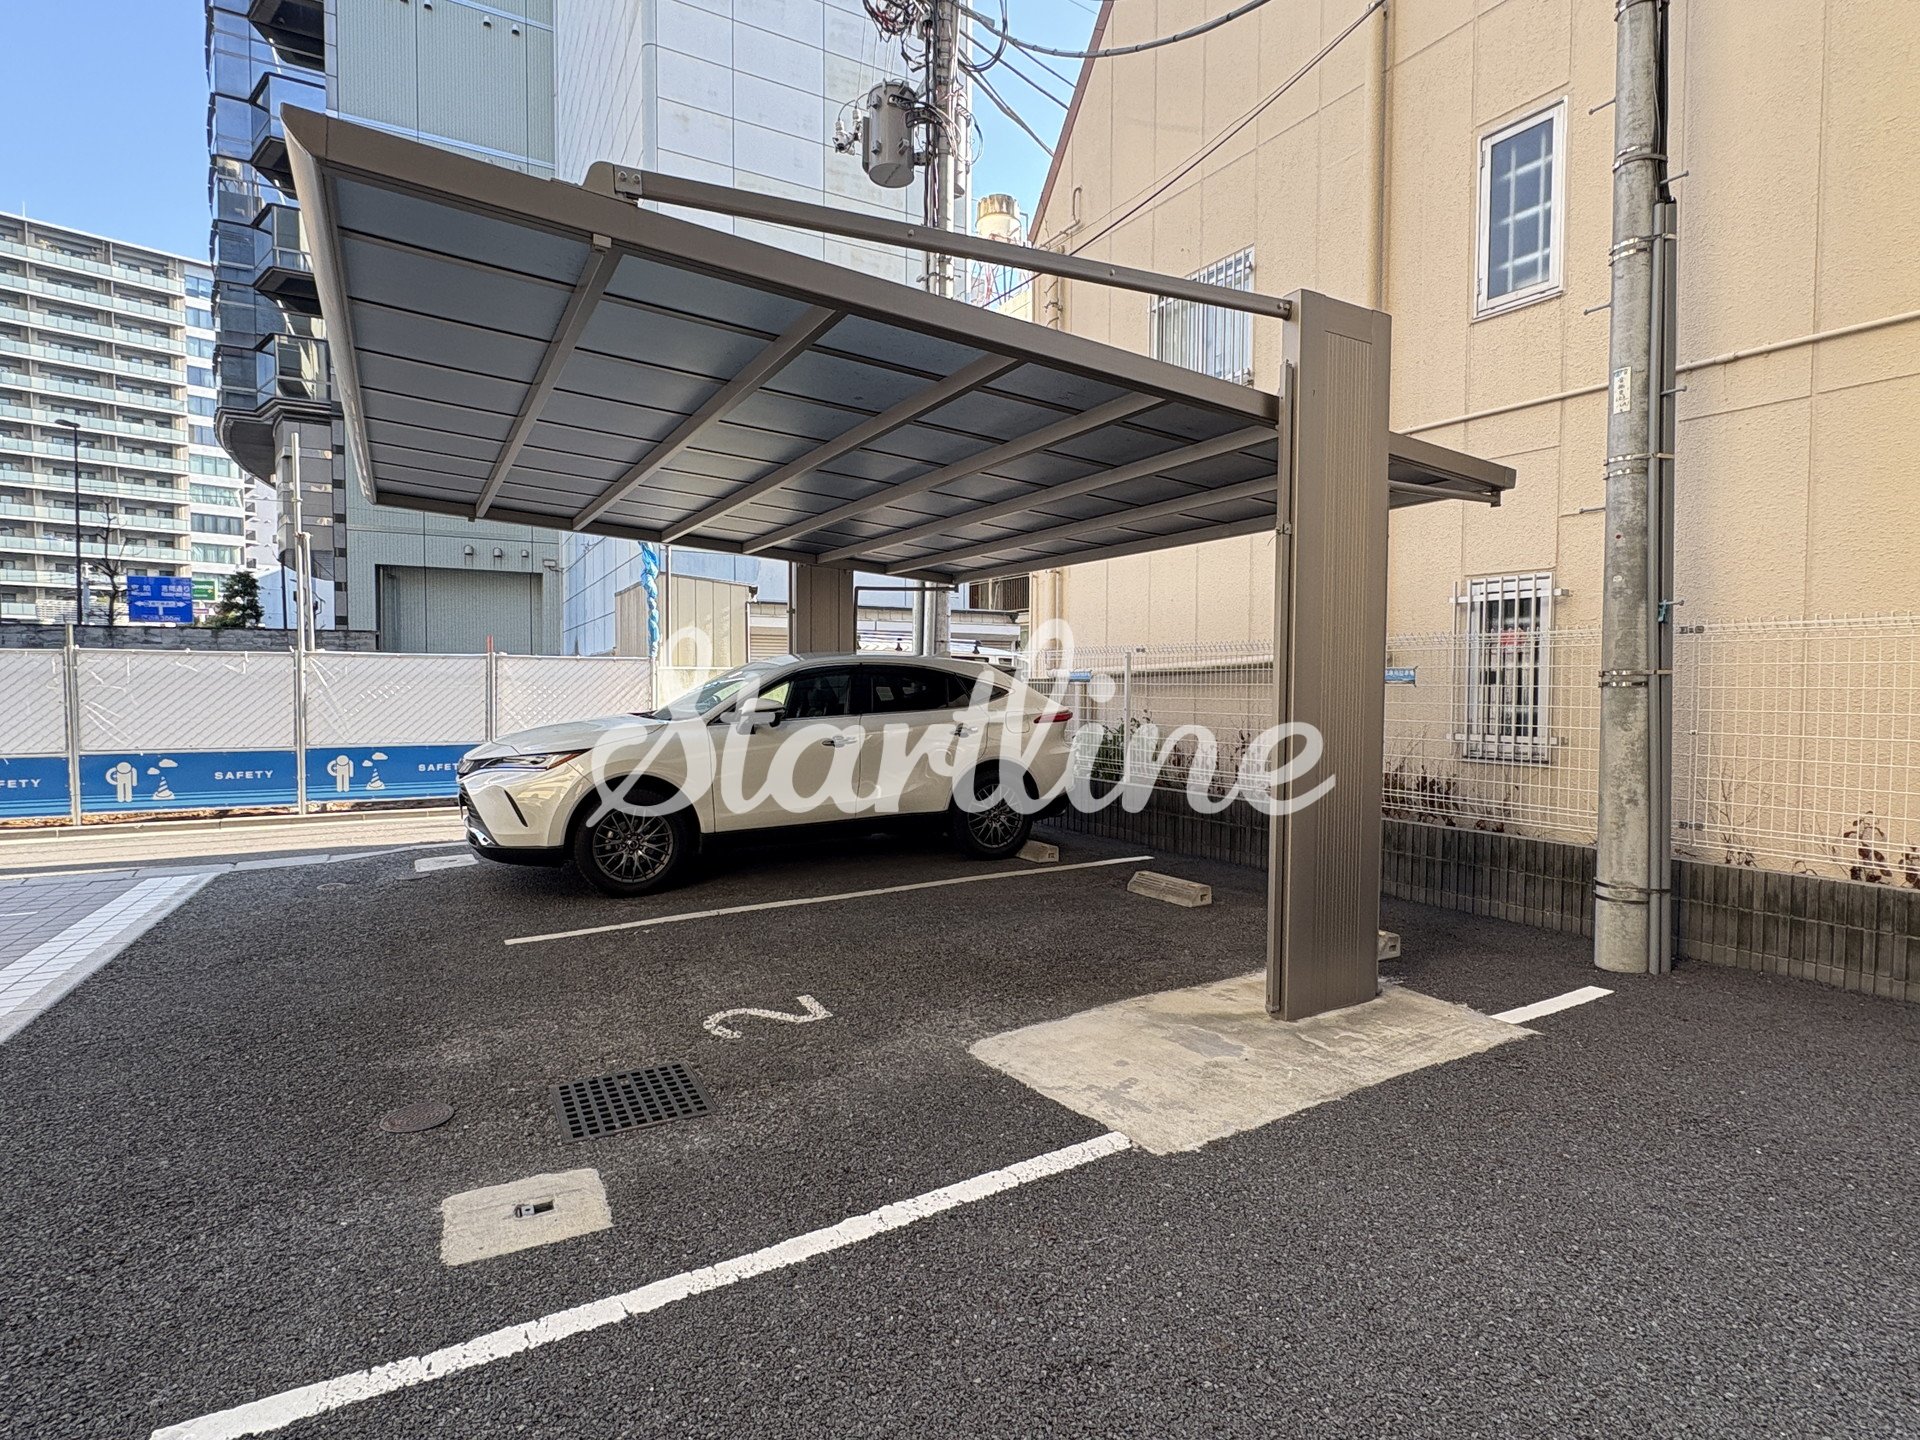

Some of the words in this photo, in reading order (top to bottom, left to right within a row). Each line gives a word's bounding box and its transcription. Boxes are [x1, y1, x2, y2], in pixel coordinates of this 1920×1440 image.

[418, 763, 458, 772] SAFET
[214, 770, 273, 780] SAFETY
[0, 779, 41, 788] FETY
[703, 994, 833, 1039] 2
